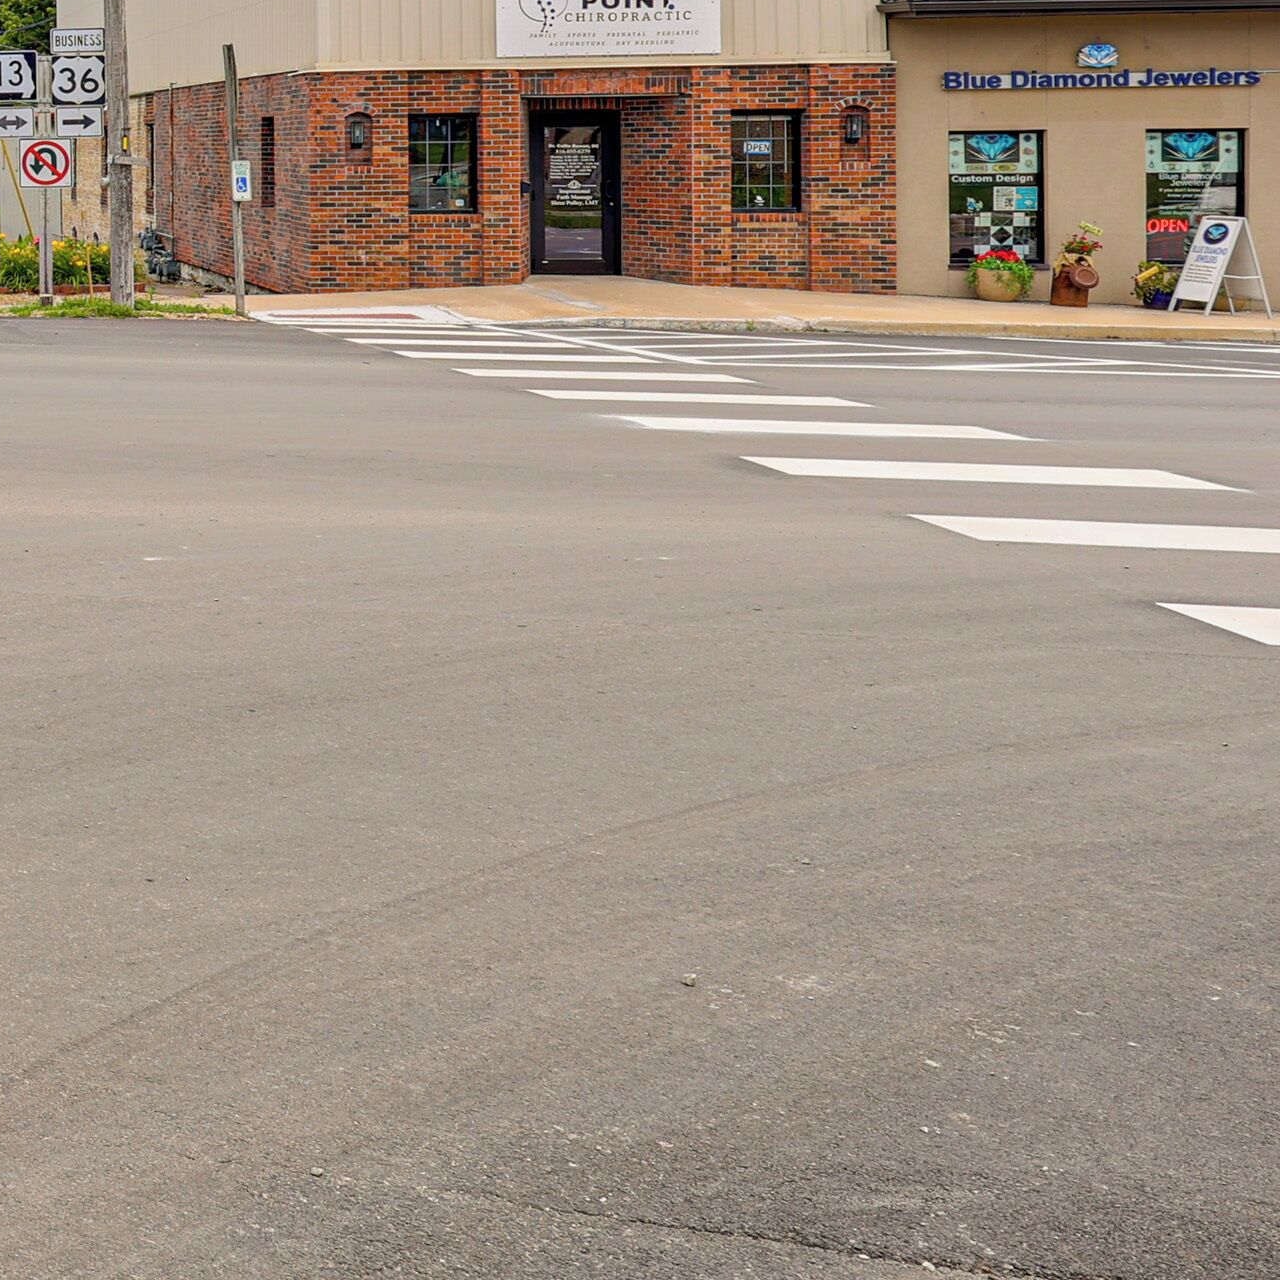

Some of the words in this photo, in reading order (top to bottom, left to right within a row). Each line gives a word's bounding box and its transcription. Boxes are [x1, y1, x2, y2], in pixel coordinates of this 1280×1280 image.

[564, 11, 692, 23] CHIROPRACTIC
[55, 35, 102, 47] BUSINESS
[58, 67, 99, 94] 36
[943, 71, 1002, 89] Blue
[1010, 69, 1129, 89] Diamond
[1137, 67, 1261, 87] Jewelers
[746, 143, 770, 152] OPEN
[951, 174, 993, 183] Custom
[996, 174, 1034, 183] Design
[1147, 219, 1189, 233] OPEN
